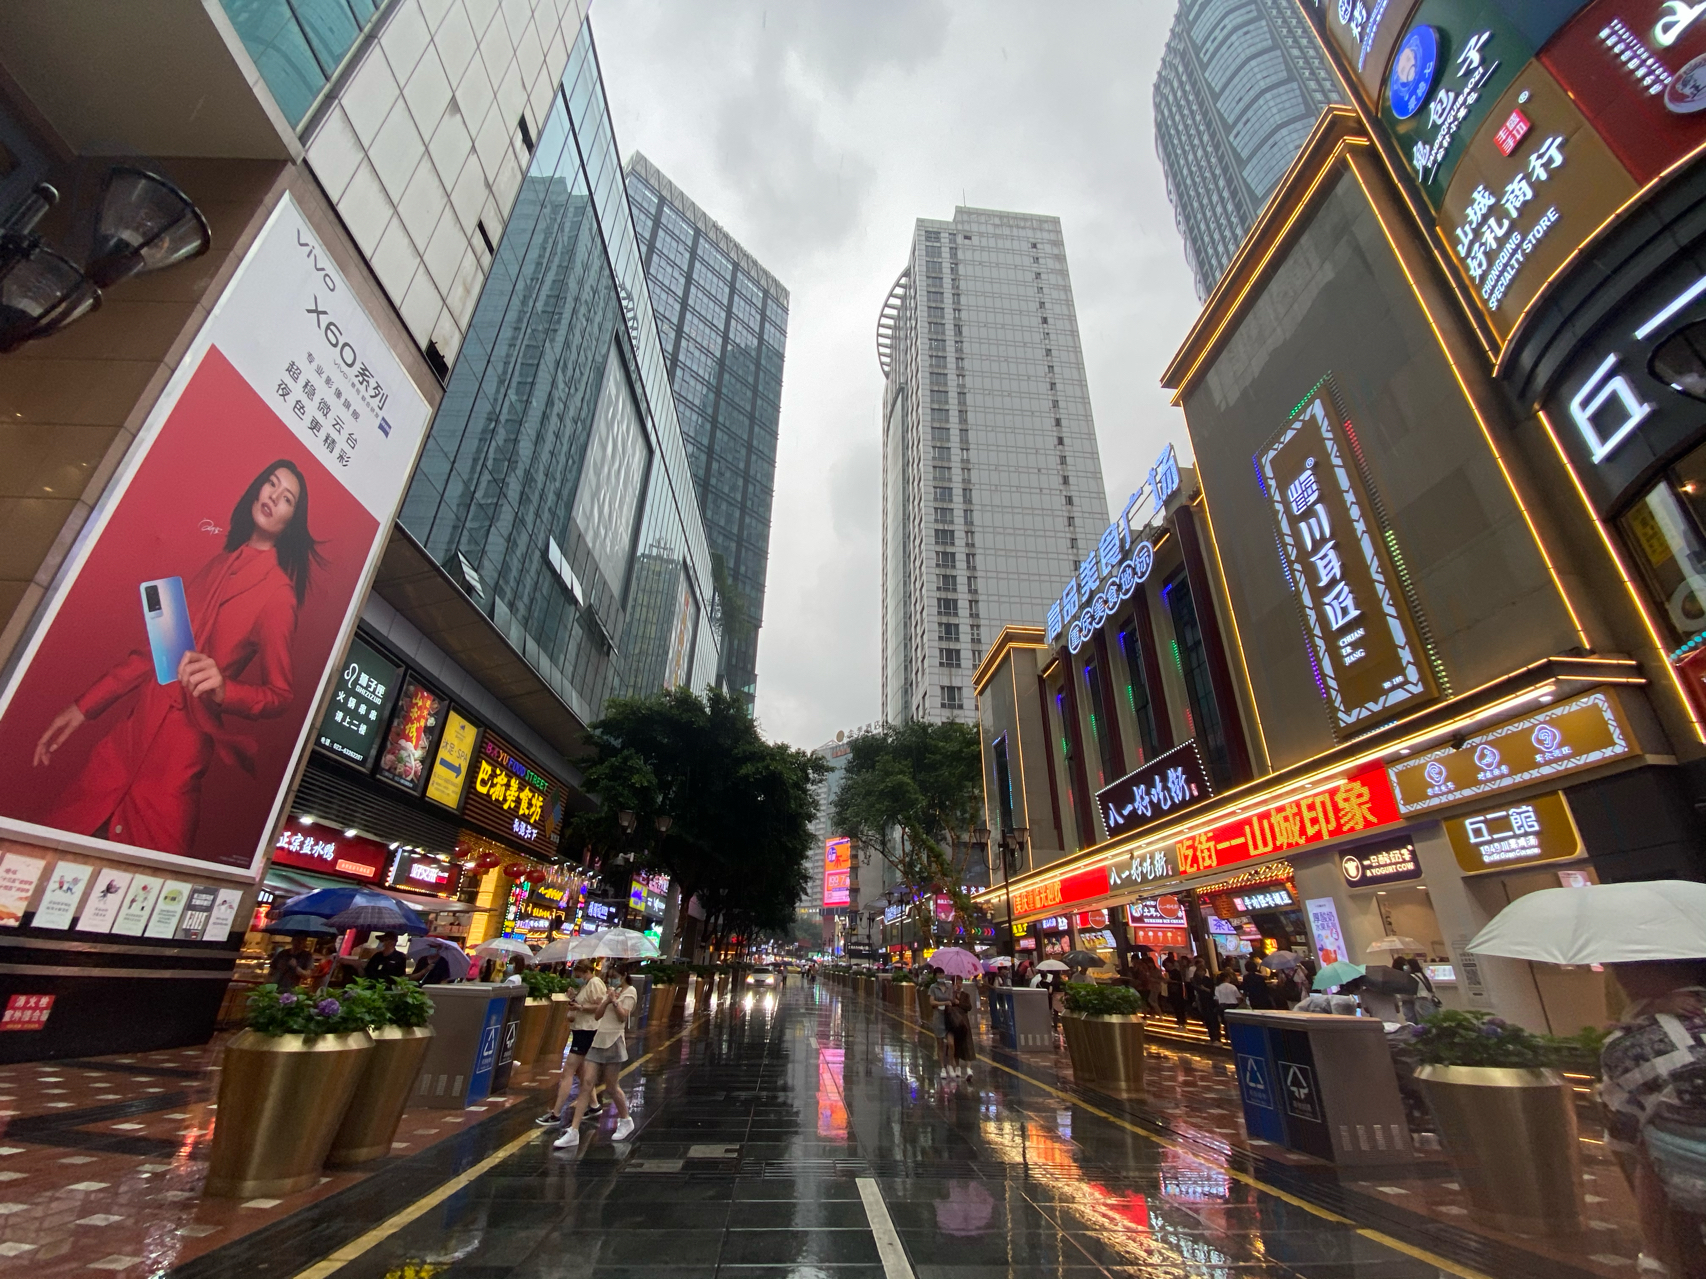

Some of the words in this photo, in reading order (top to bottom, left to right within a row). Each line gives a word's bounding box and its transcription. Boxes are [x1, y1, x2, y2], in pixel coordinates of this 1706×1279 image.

[1455, 184, 1496, 258] 山城
[1466, 136, 1564, 284] 好礼商行
[295, 227, 336, 293] vivo
[1482, 231, 1522, 300] CHONGQING
[1488, 249, 1524, 311] SPECIALTY
[1522, 206, 1559, 253] STORE
[305, 293, 389, 412] X60系列
[275, 378, 352, 467] 夜色更精彩
[285, 360, 358, 450] 超稳微云台
[1069, 542, 1153, 653] 重庆美食地标
[1339, 627, 1365, 647] CHUAN
[1342, 646, 1353, 656] ER
[1343, 649, 1365, 666] JIANG
[334, 710, 368, 736] 请上二楼
[475, 759, 544, 824] 巴渝美食坊
[498, 750, 509, 765] YU
[507, 757, 526, 777] FOOD
[524, 769, 549, 793] STREET
[276, 831, 336, 861] 正宗盐水鸭
[1362, 848, 1413, 867] 一只酸奶牛
[1371, 864, 1397, 876] YOGURT
[1397, 861, 1415, 872] COW
